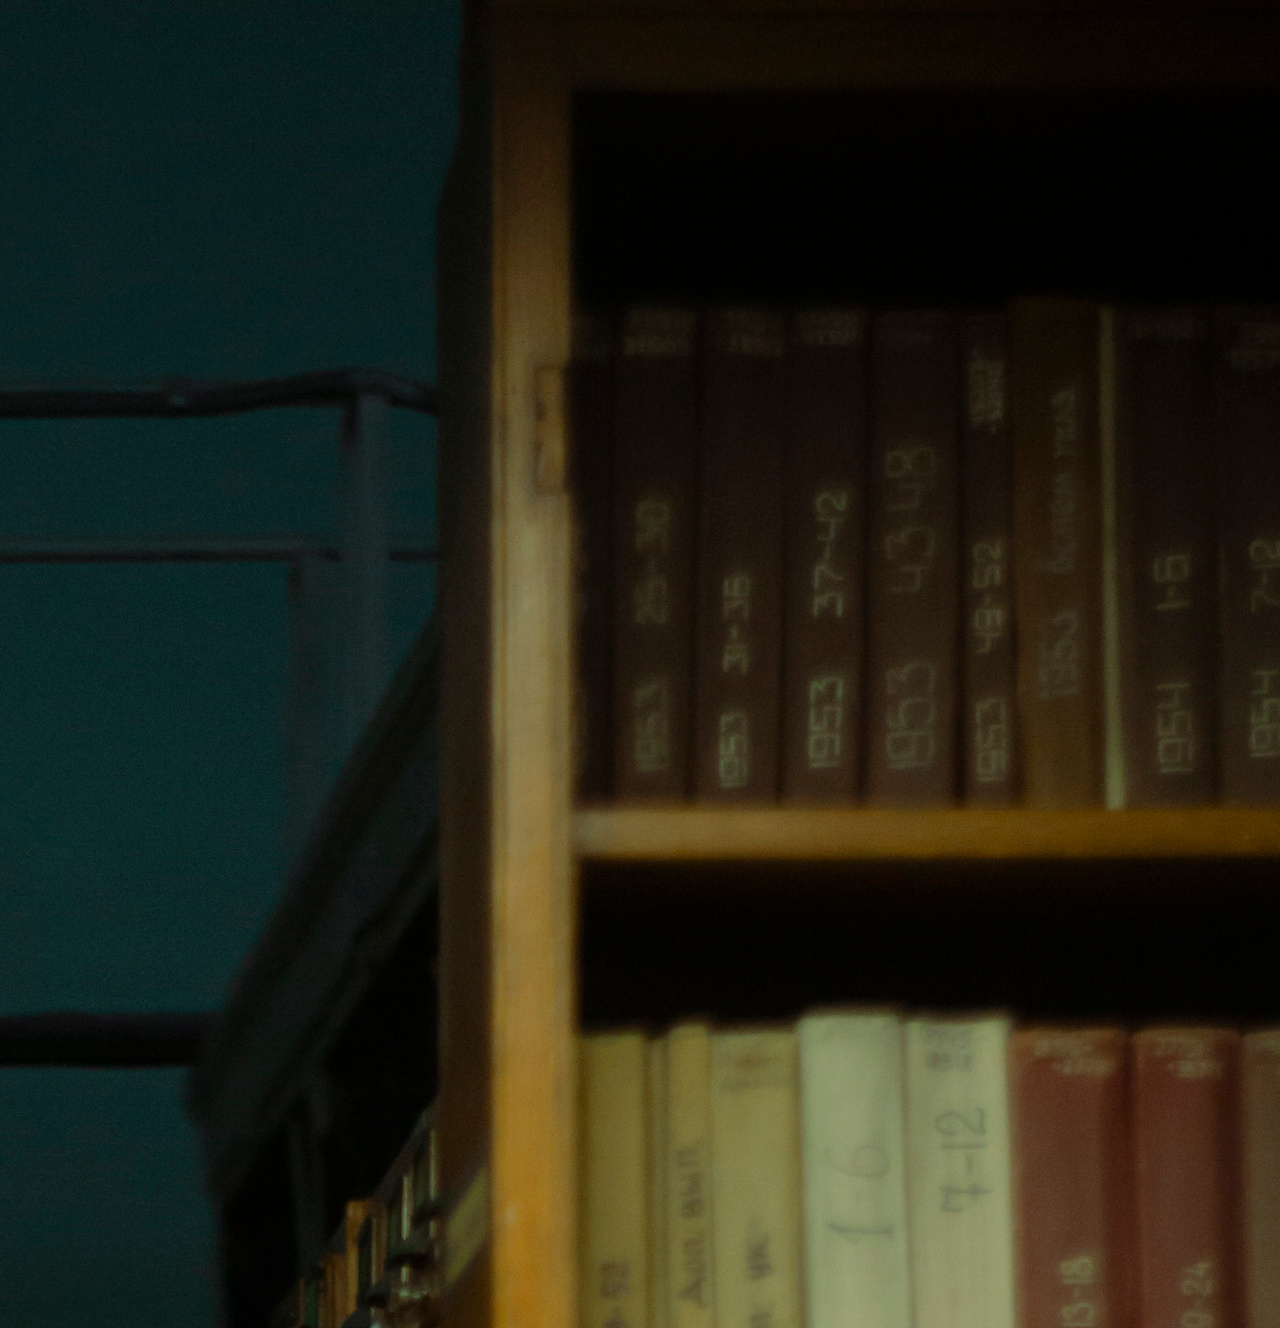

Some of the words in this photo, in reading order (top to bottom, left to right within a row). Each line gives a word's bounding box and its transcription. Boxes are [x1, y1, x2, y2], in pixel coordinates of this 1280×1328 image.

[811, 490, 848, 618] 37-42
[1154, 553, 1191, 611] 1-6
[1248, 539, 1280, 612] 7-12
[719, 711, 749, 787] 1953
[807, 677, 844, 768] 1953
[885, 661, 935, 769] 1953
[974, 698, 1006, 783] 1953
[1156, 682, 1193, 773] 1954
[1250, 670, 1280, 758] 1954
[933, 1107, 990, 1213] 7-12
[1061, 1255, 1096, 1328] 13-18
